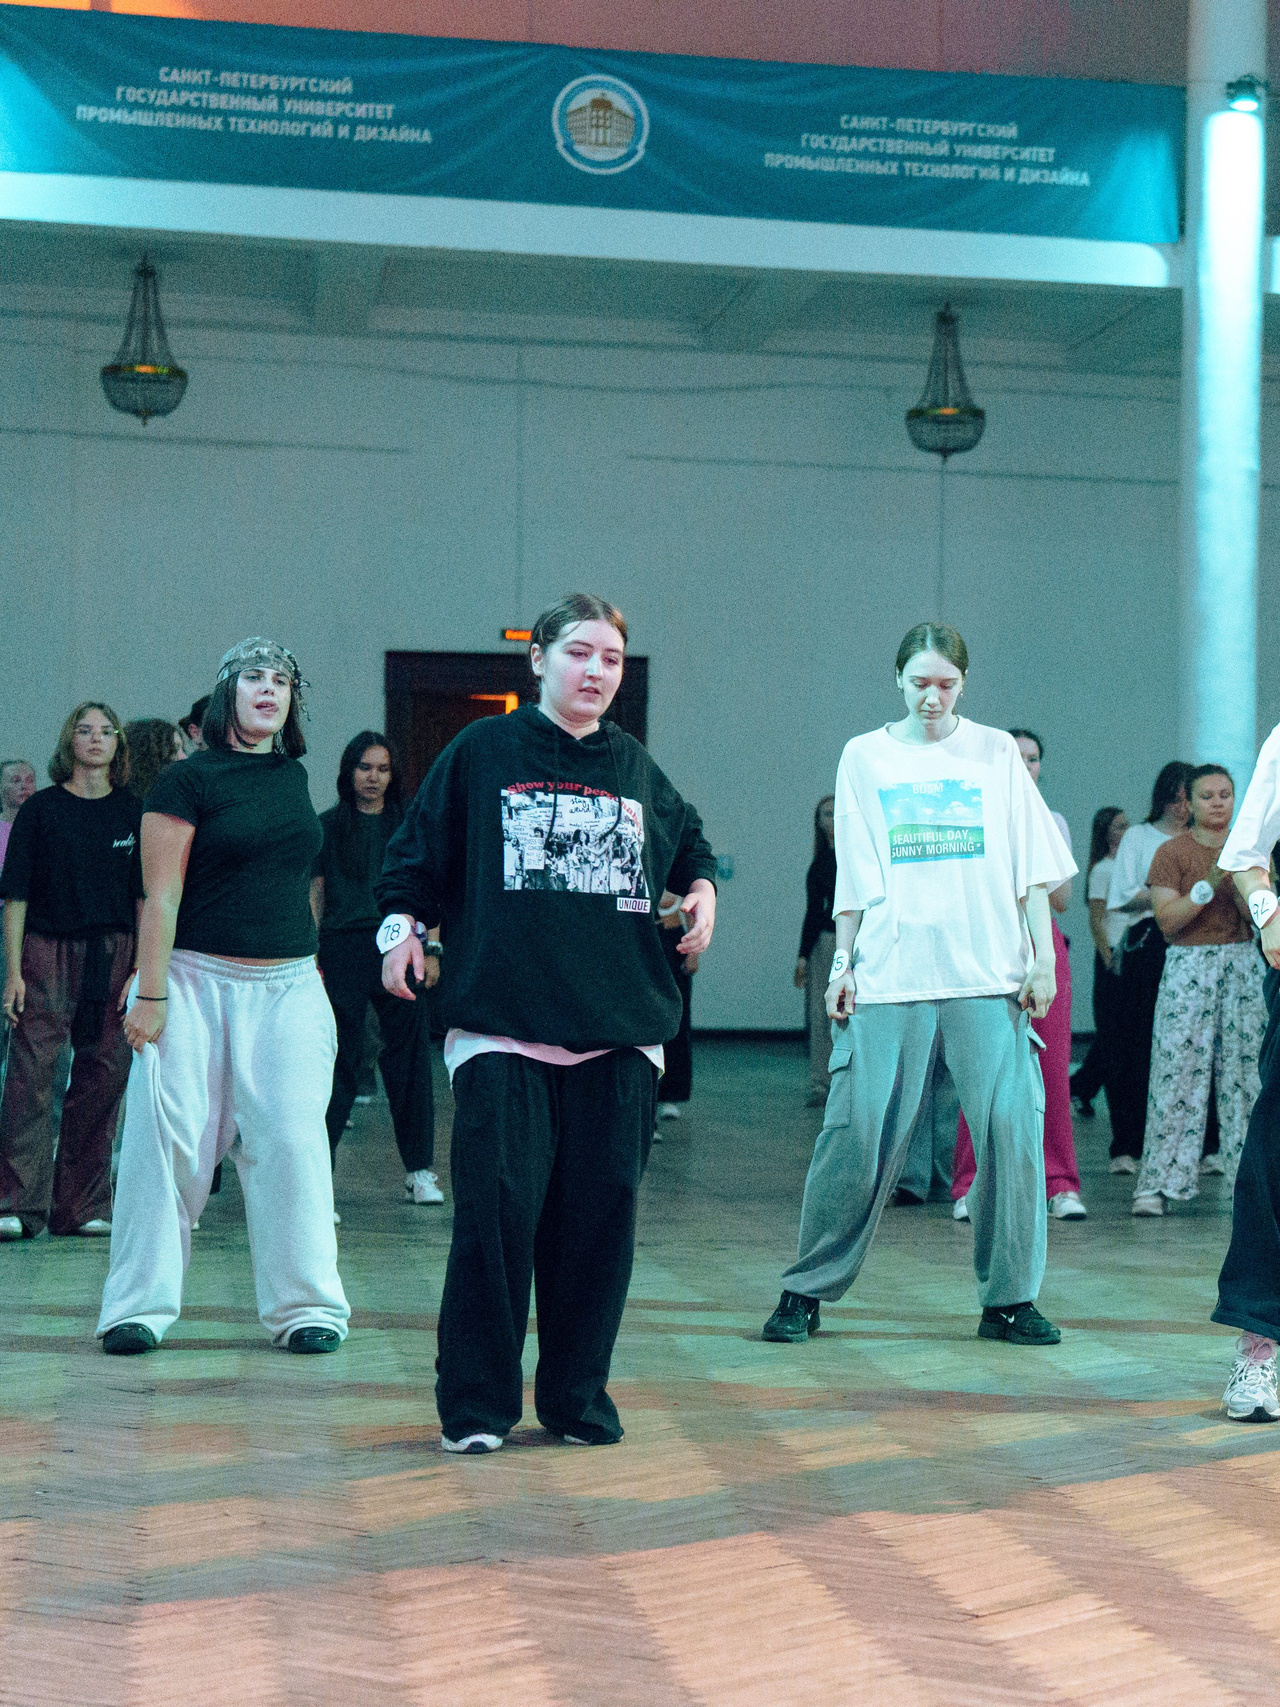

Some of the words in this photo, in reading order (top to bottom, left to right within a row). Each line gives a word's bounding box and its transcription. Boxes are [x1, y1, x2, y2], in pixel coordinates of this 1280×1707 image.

[158, 66, 353, 95] САНКТ-ПЕТЕРБУРГСКИЙ
[116, 85, 279, 113] ГОСУДАРСТВЕННЫЙ
[283, 98, 395, 120] УНИВЕРСИТЕТ
[76, 104, 223, 131] ПРОМЫШЛЕННЫХ
[228, 116, 334, 138] ТЕХНОЛОГИЙ
[337, 123, 350, 139] И
[353, 124, 433, 144] ДИЗАЙНА
[840, 114, 1018, 139] САНКТ-ПЕТЕРБУРГСКИЙ
[801, 133, 950, 156] ГОСУДАРСТВЕННЫЙ
[953, 143, 1055, 162] УНИВЕРСИТЕТ
[764, 153, 899, 175] ПРОМЫШЛЕННЫХ
[902, 161, 1001, 180] ТЕХНОЛОГИЙ
[1003, 166, 1016, 182] И
[1018, 166, 1090, 187] ДИЗАЙНА
[506, 781, 544, 796] Show
[545, 781, 582, 792] your
[926, 841, 975, 855] MORNING
[618, 899, 648, 911] UNIQUE
